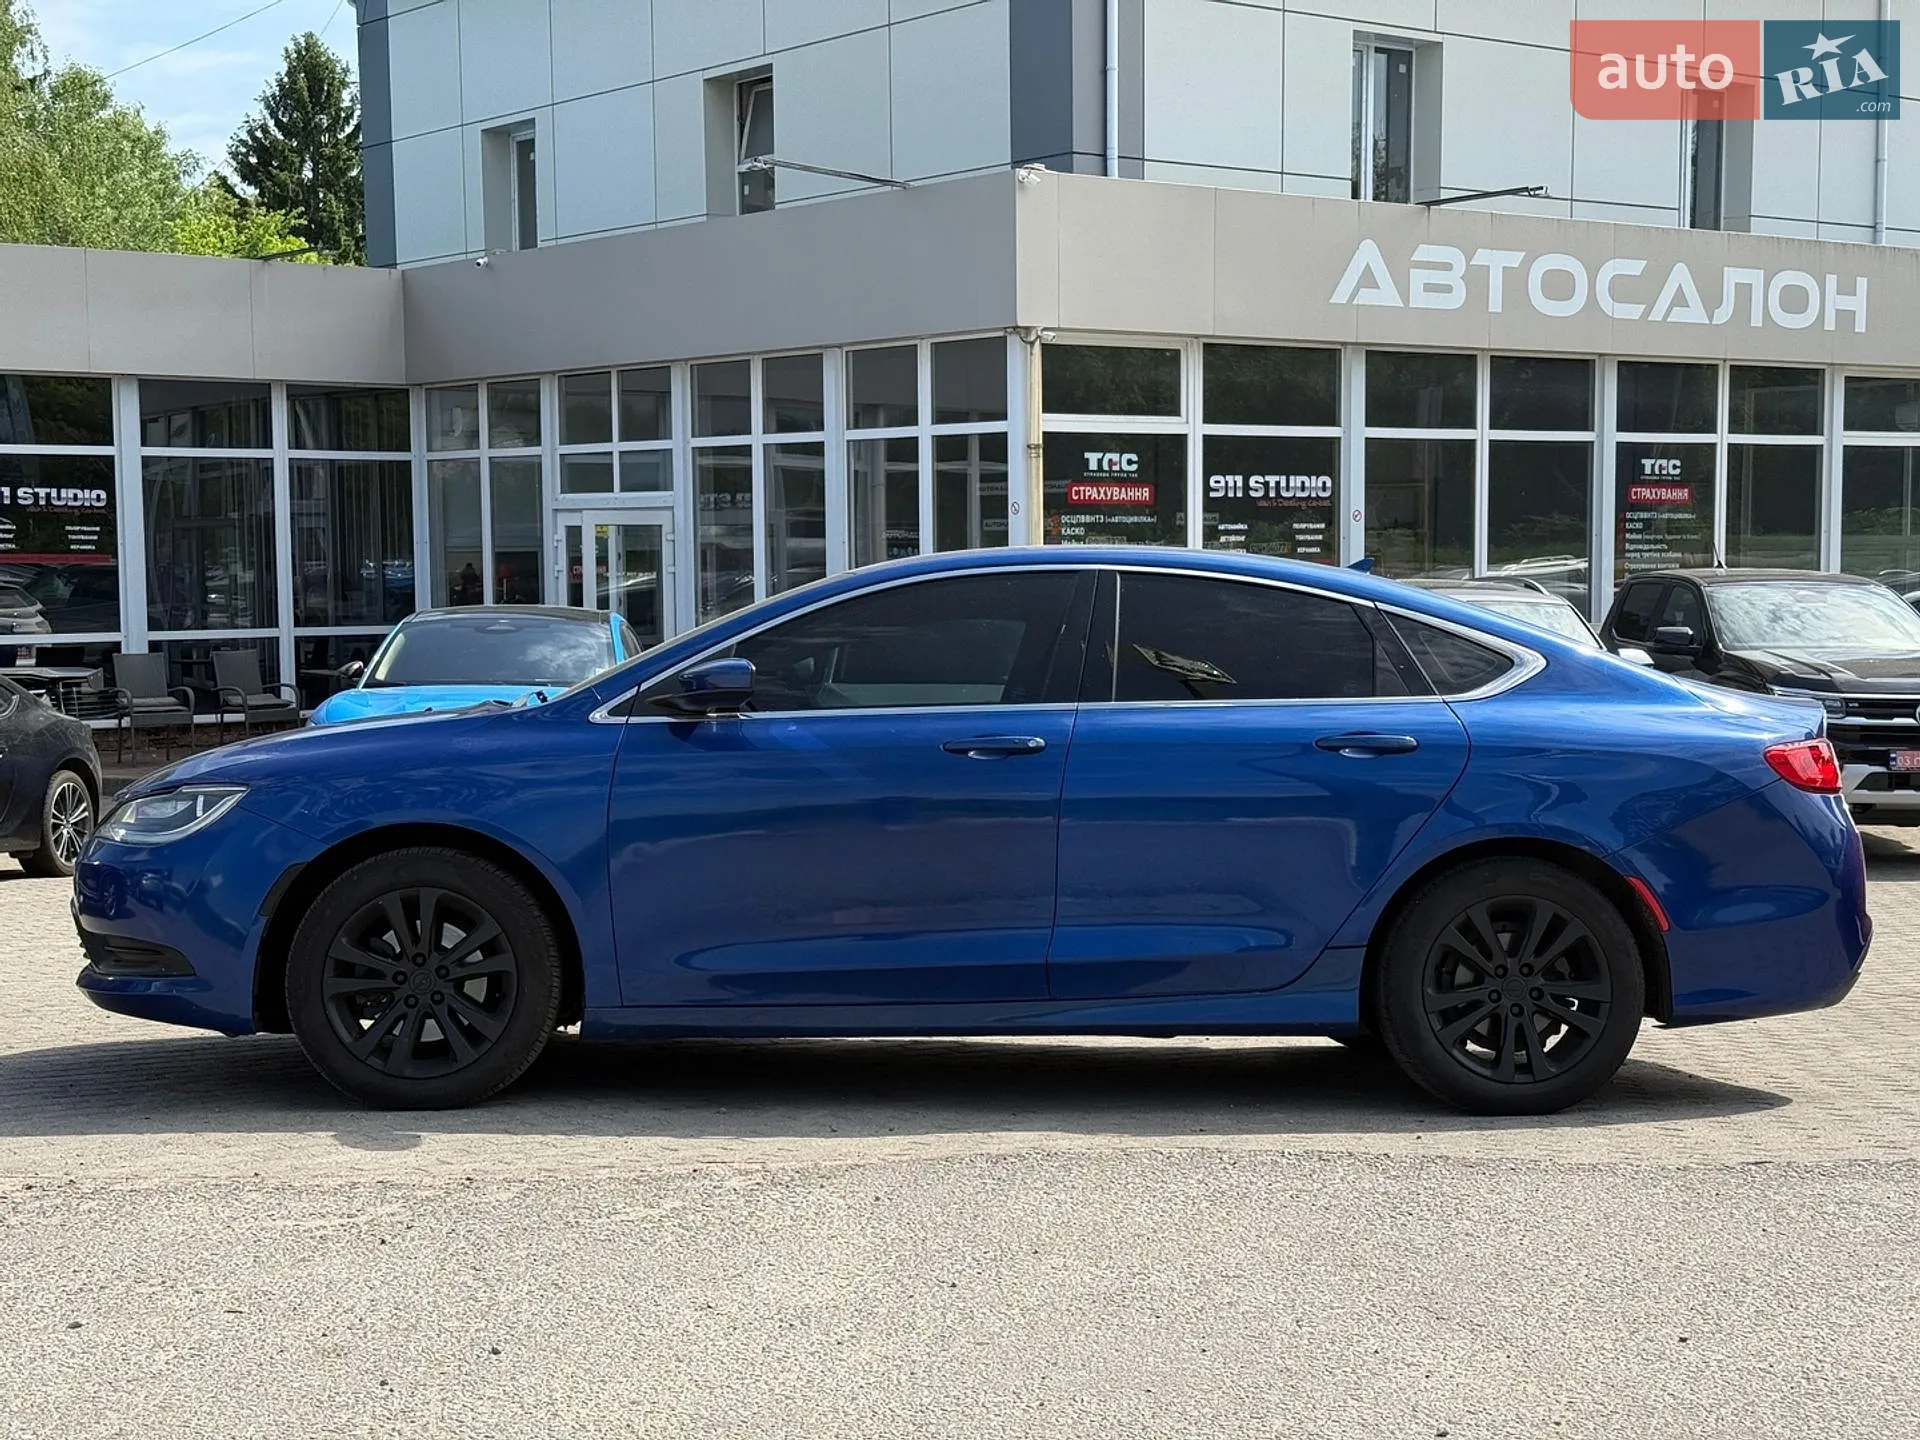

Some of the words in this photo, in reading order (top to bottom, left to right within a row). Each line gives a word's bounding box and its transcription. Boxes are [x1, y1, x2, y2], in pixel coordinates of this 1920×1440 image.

[1329, 238, 1868, 333] АВТОСАЛОН
[1072, 486, 1149, 500] СТРАХУВАННЯ
[1209, 475, 1243, 498] 911
[1249, 475, 1332, 498] STUDIO
[1631, 487, 1689, 500] СТРАХУВАННЯ
[17, 487, 107, 507] STUDIO
[1061, 527, 1085, 535] КАСКО
